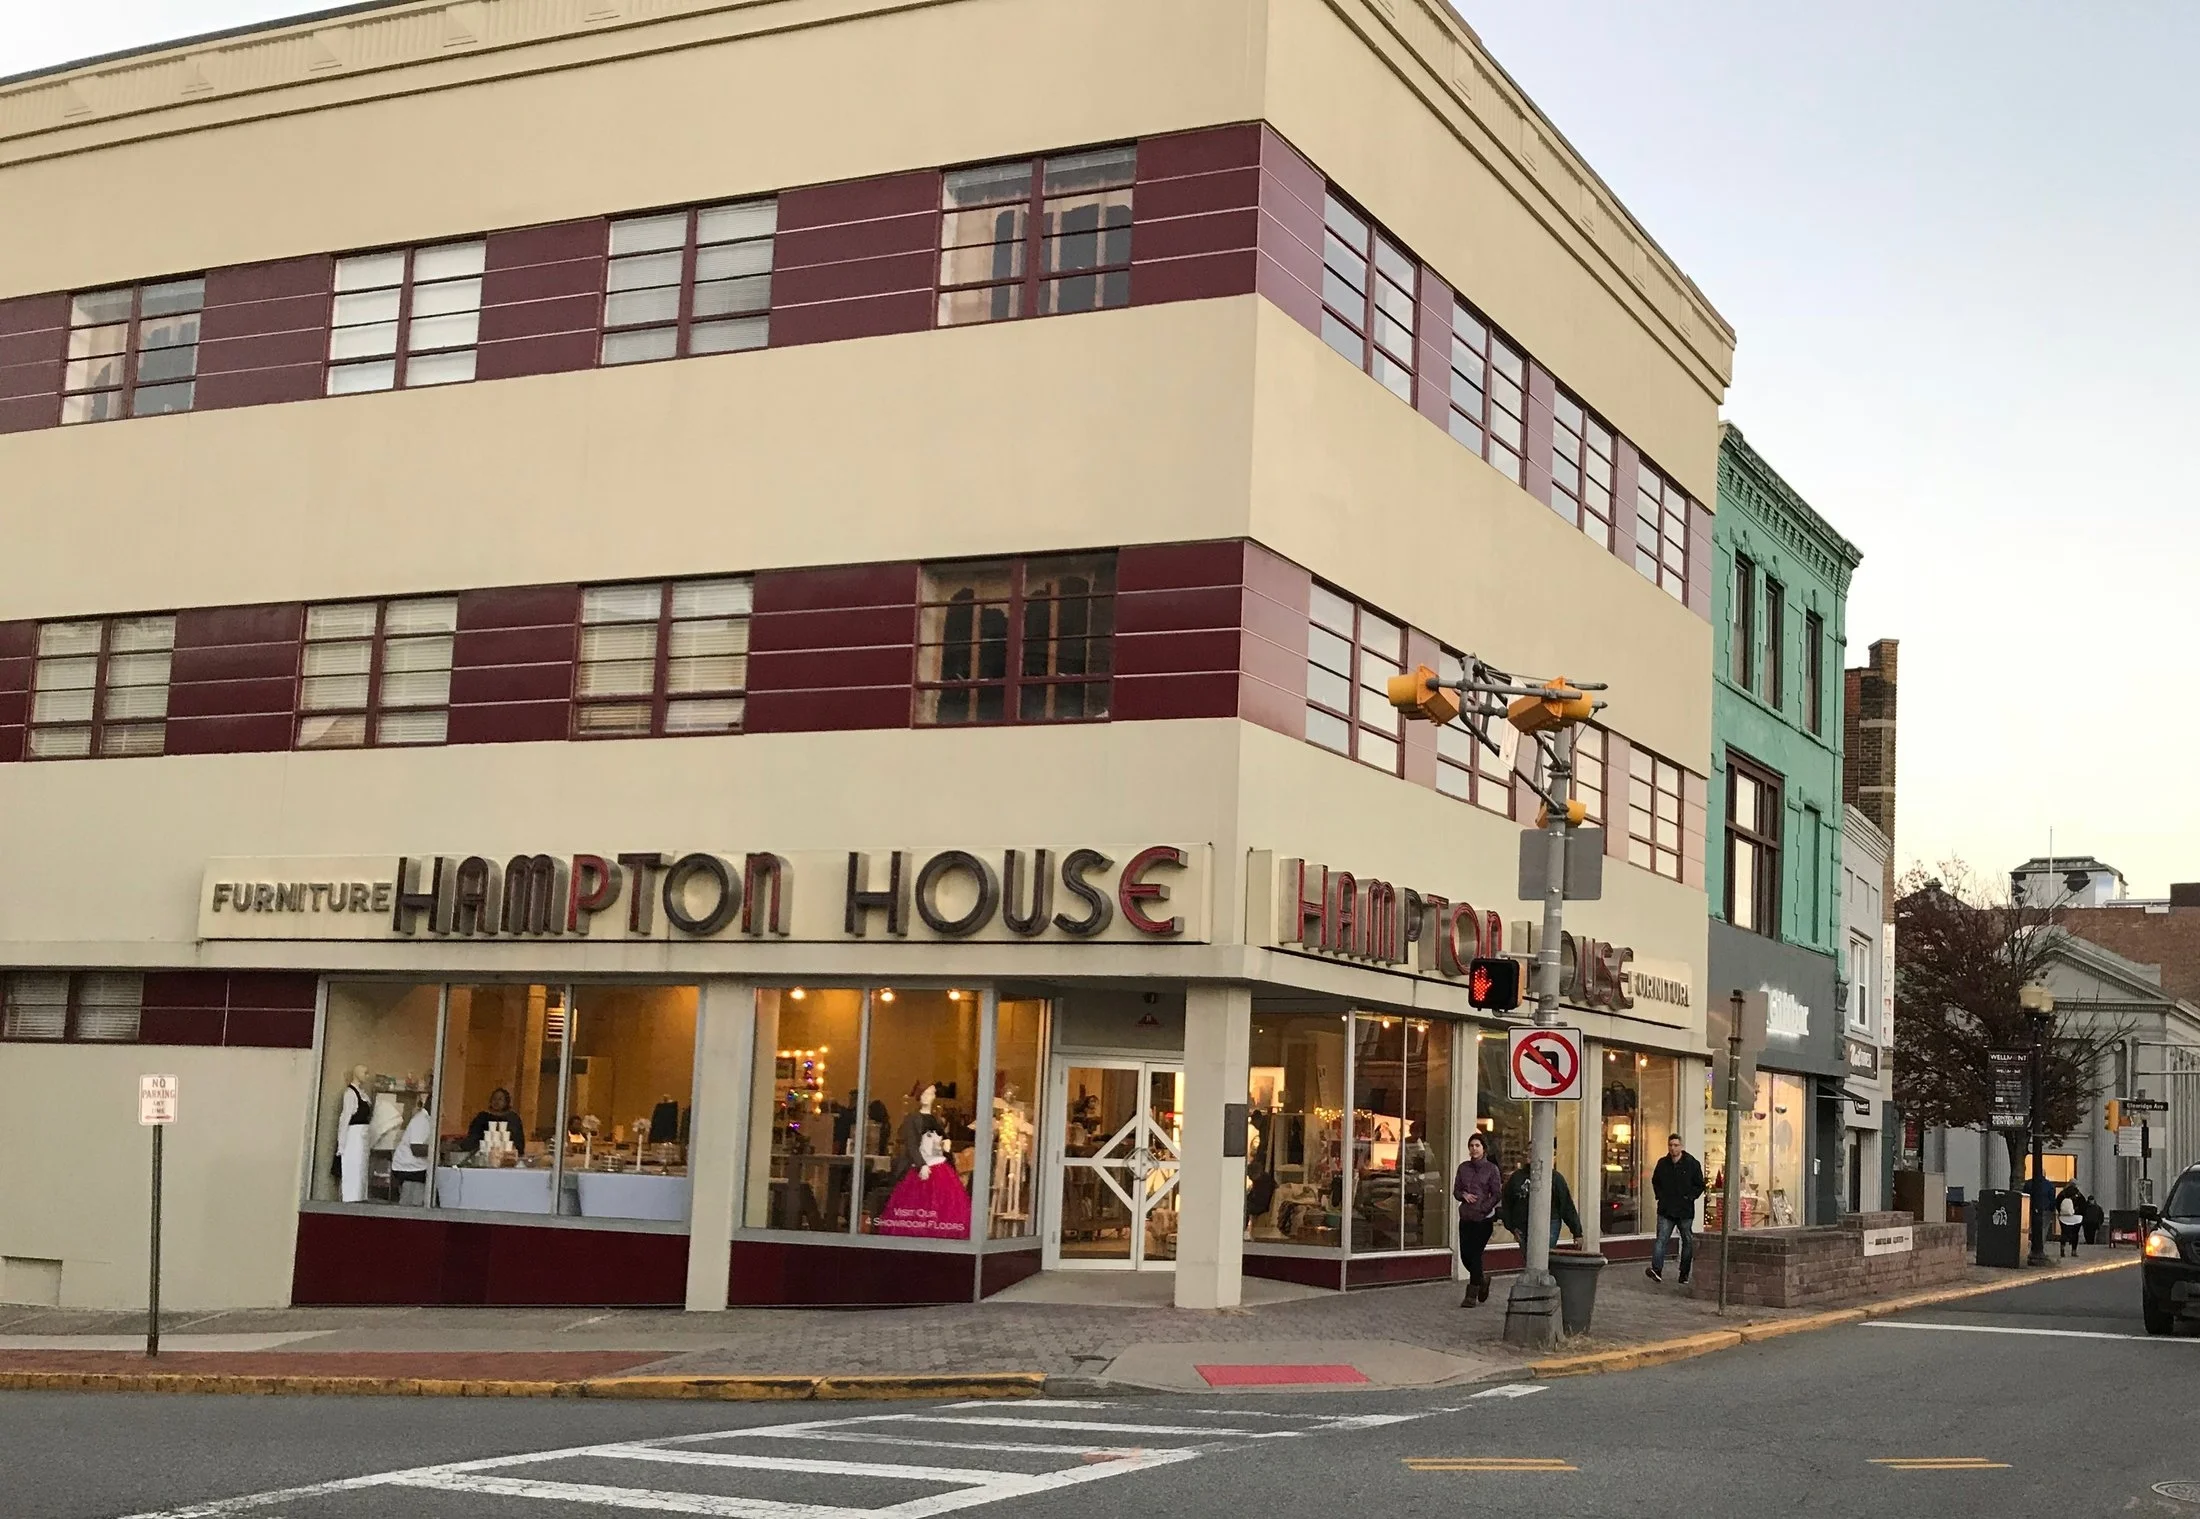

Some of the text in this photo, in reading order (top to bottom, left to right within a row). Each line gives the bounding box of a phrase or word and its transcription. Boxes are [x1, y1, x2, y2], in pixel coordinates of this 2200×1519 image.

[211, 845, 1189, 938] FURNITURE HAMPTON HOUSE
[1278, 857, 1503, 978] HAMPTON
[142, 1089, 176, 1099] PARKING
[152, 1078, 166, 1088] NO
